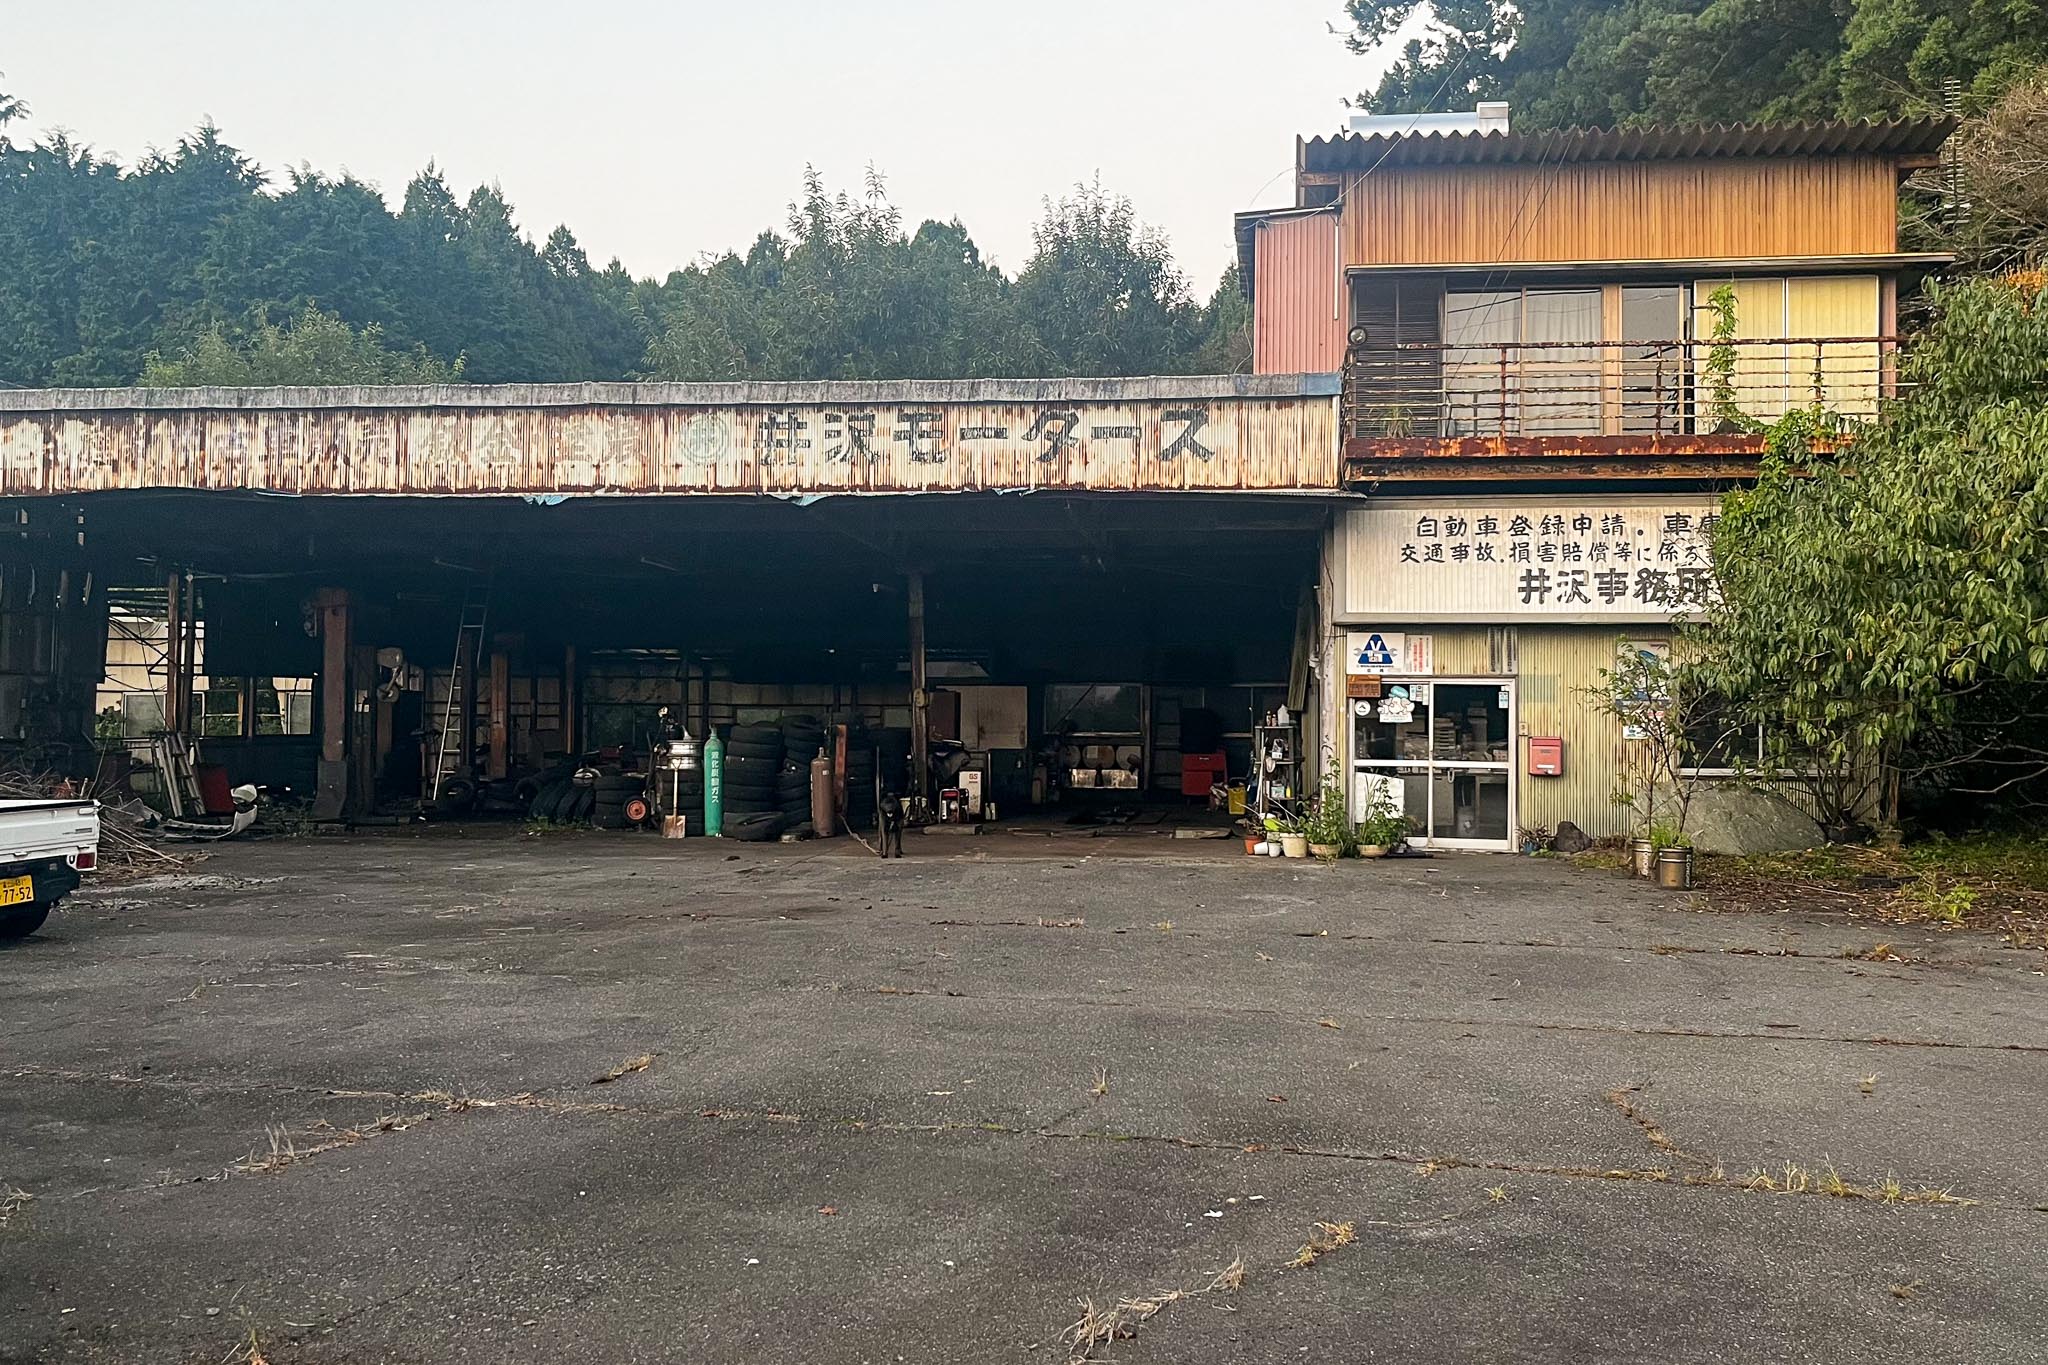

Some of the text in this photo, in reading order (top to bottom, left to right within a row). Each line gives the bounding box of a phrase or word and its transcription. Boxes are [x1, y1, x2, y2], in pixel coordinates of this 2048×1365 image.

[753, 409, 1214, 466] 井沢モータース
[1518, 567, 1708, 605] 井沢事務所
